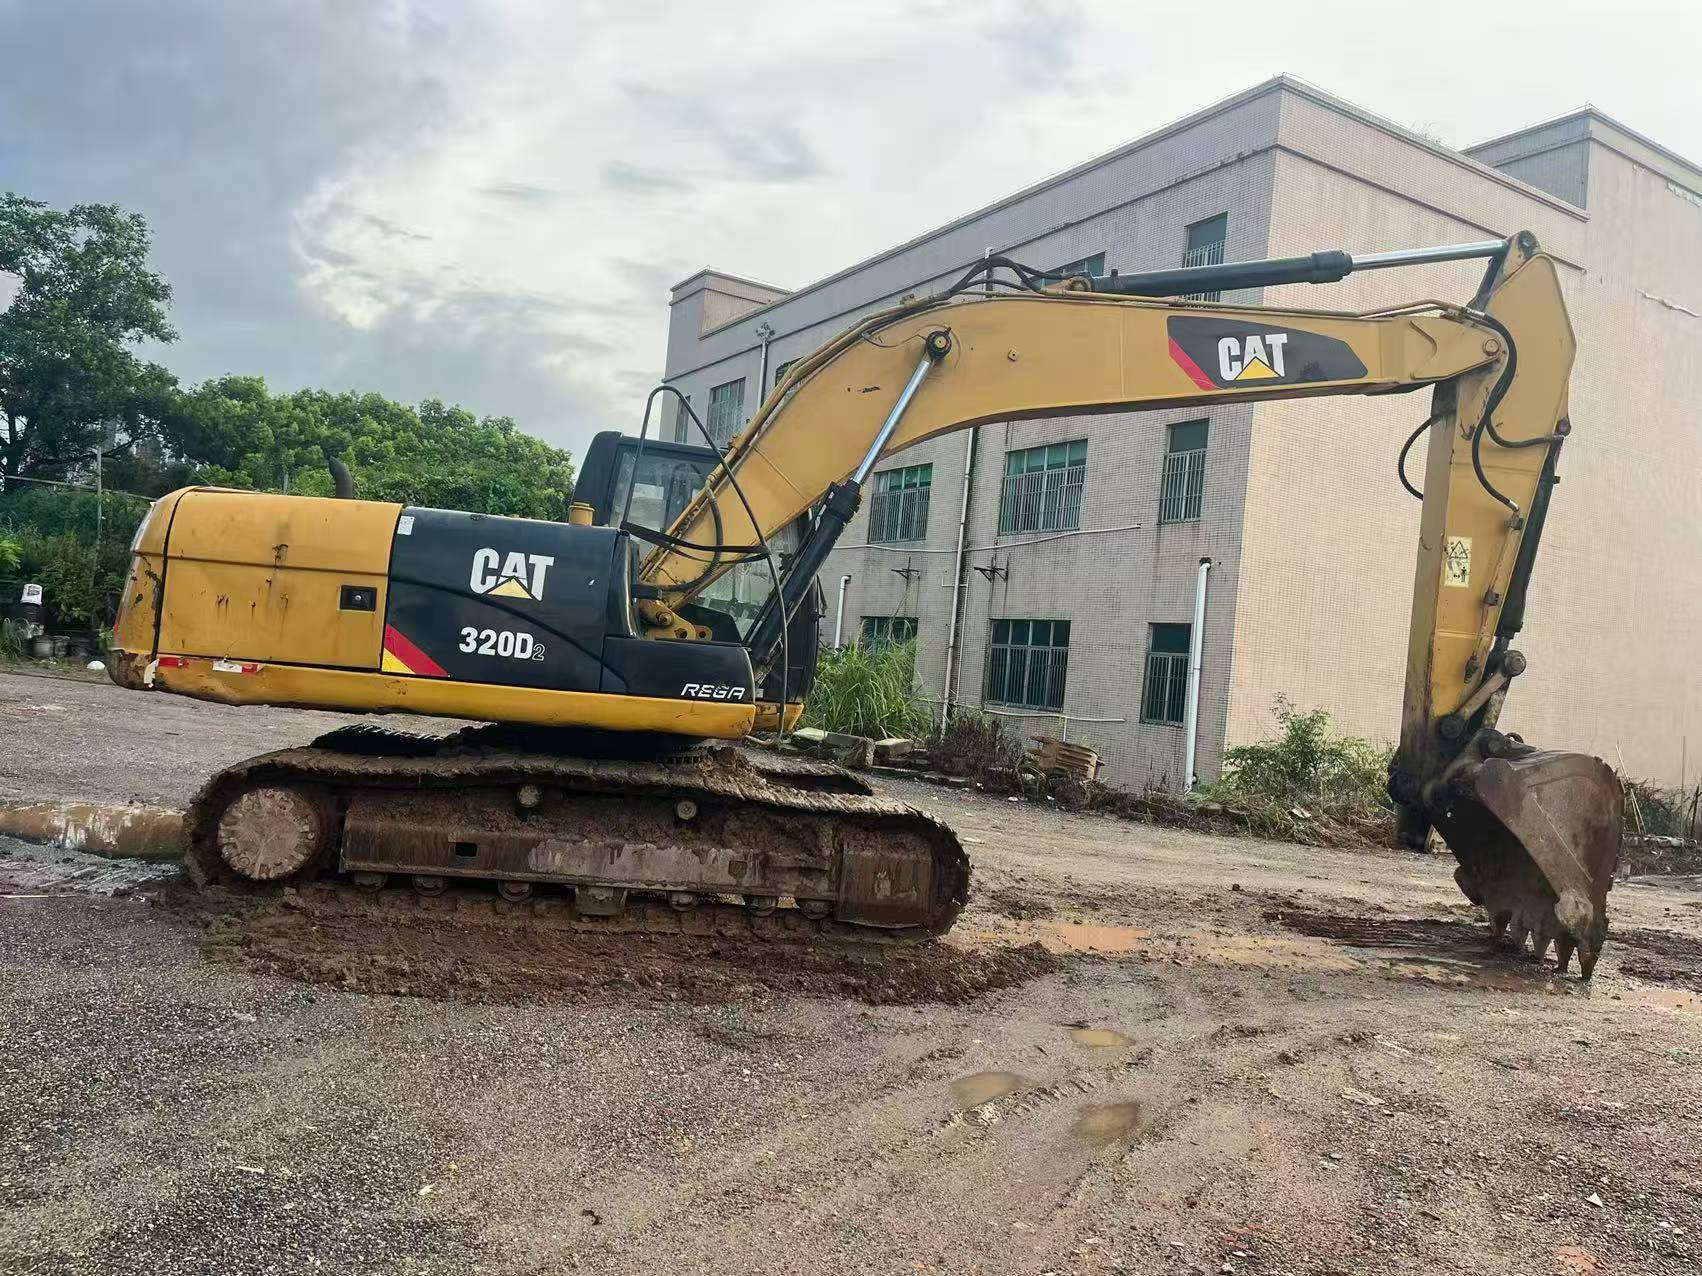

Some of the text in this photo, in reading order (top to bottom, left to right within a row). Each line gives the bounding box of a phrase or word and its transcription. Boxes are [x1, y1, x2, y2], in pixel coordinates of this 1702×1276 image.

[1217, 333, 1288, 381] CAT
[469, 547, 555, 601] CAT
[459, 626, 546, 661] 320D2
[680, 683, 746, 700] REGA
